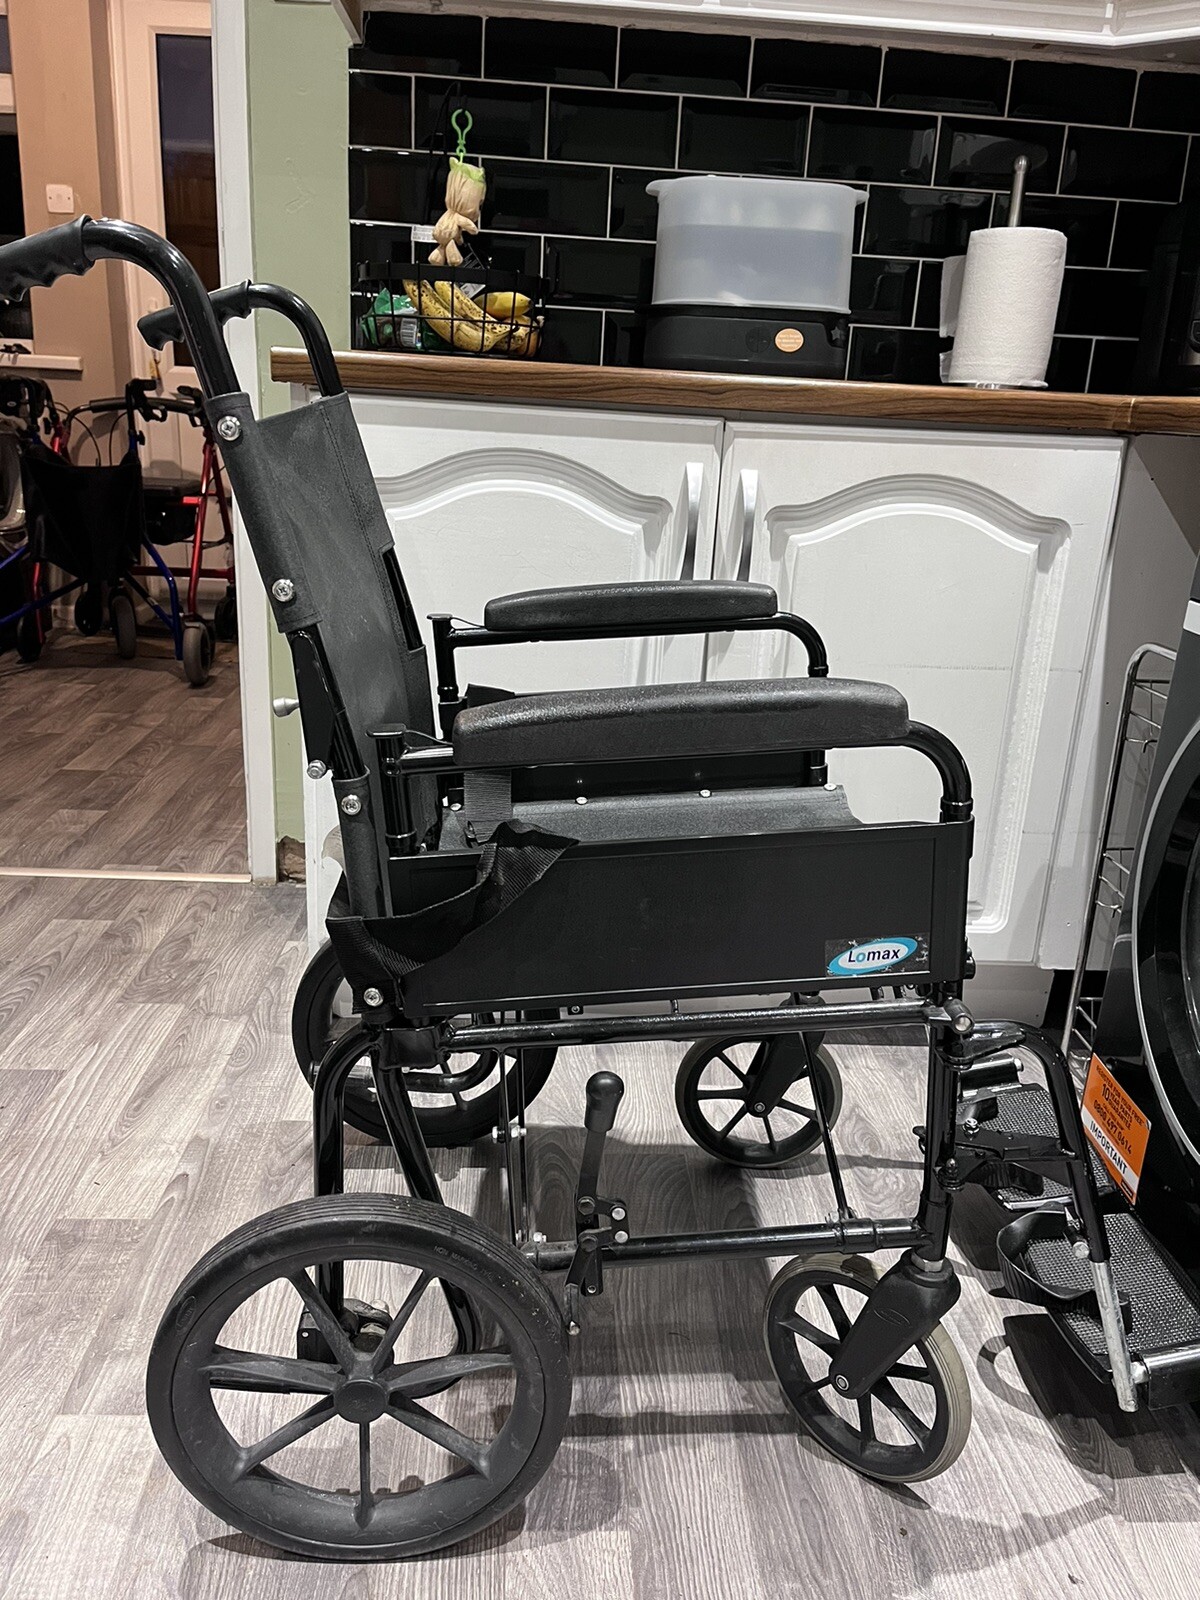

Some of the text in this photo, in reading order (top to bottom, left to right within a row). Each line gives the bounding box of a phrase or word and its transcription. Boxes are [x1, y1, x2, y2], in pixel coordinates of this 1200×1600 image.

[848, 948, 901, 963] Lomax
[1102, 1084, 1110, 1101] 10
[1094, 1100, 1107, 1121] 0800
[1107, 1118, 1118, 1134] 497
[1118, 1131, 1132, 1154] 0614
[1090, 1121, 1127, 1174] IMPORTANT
